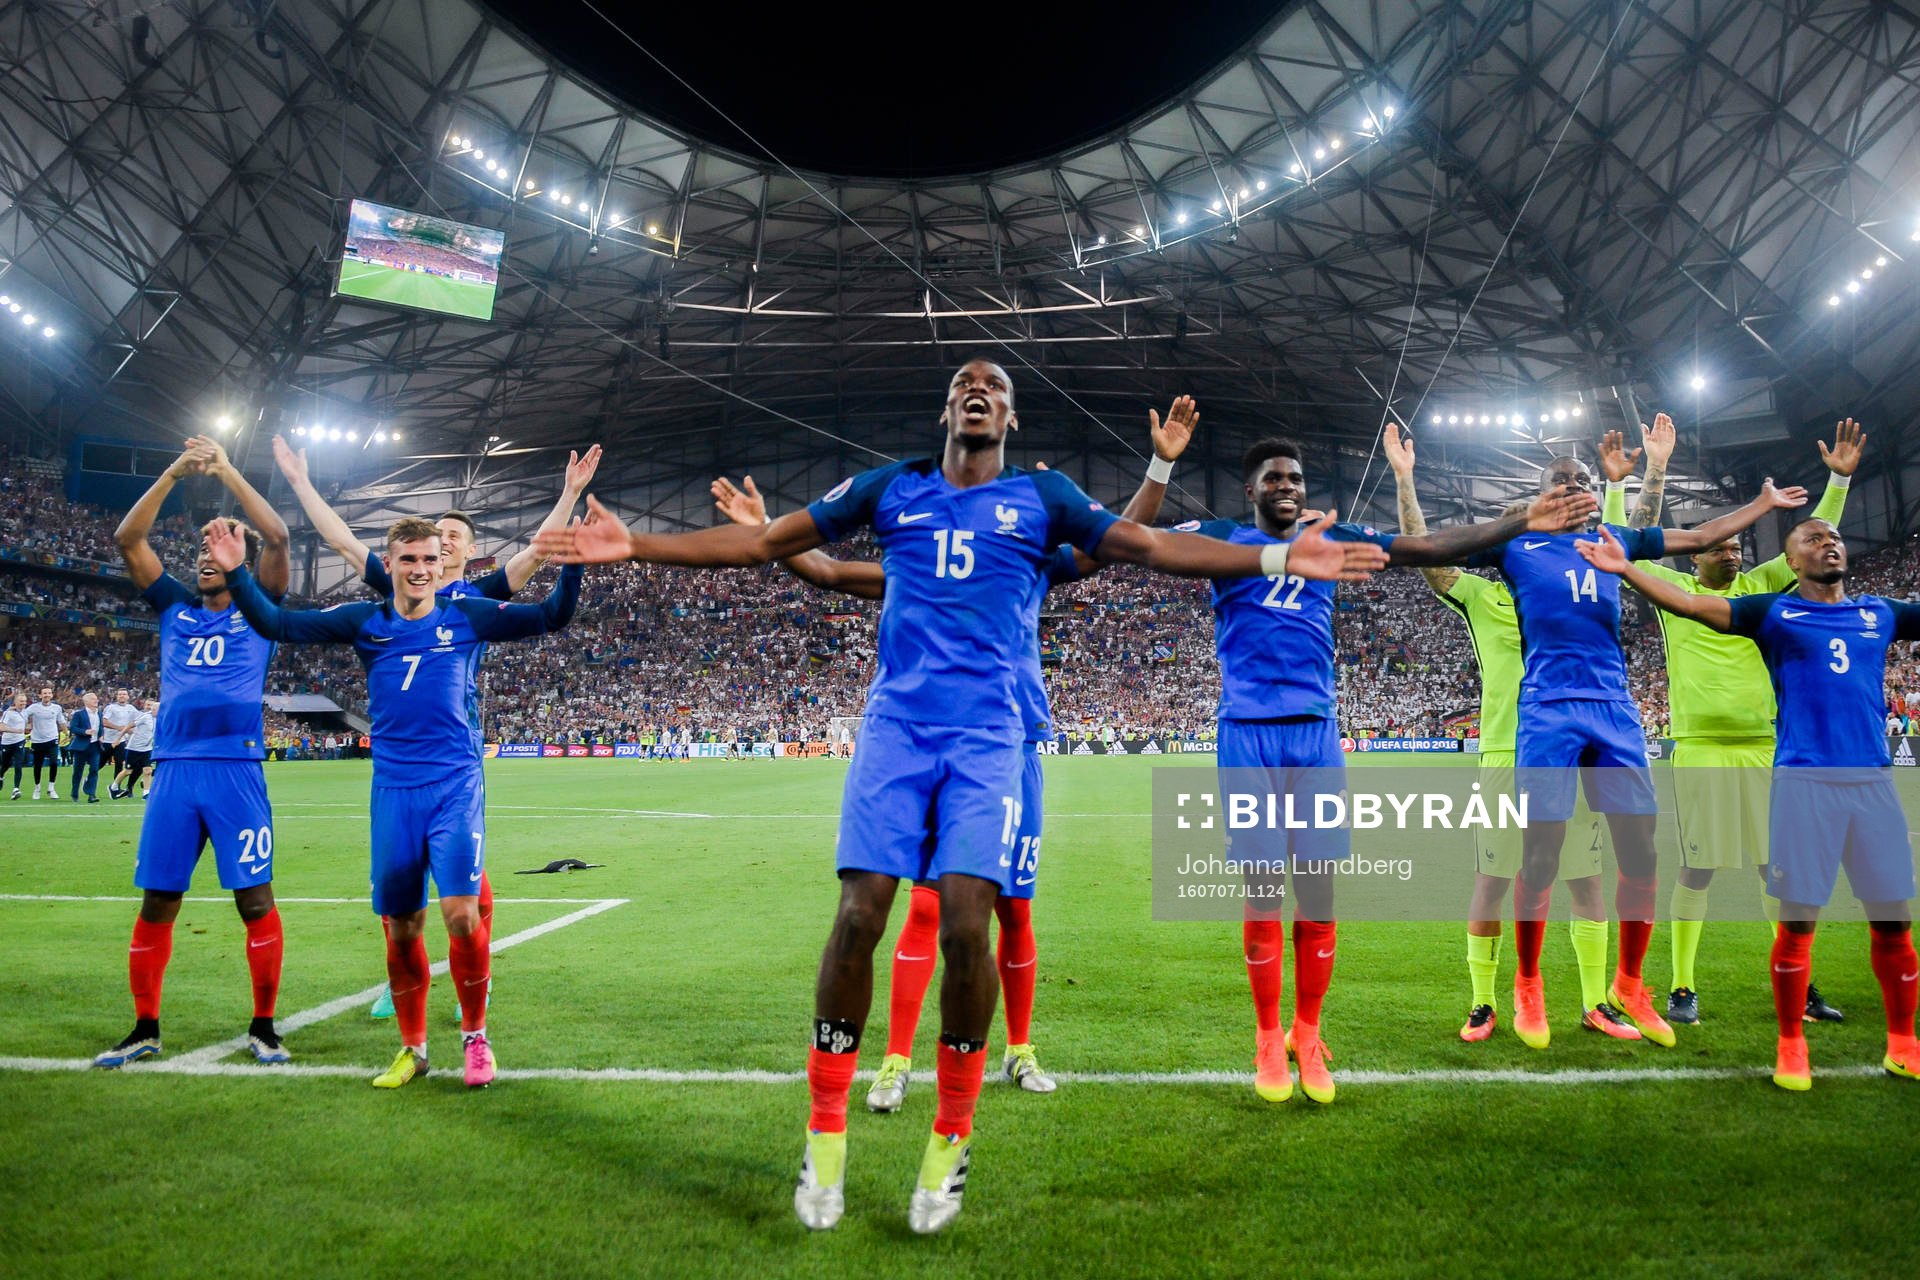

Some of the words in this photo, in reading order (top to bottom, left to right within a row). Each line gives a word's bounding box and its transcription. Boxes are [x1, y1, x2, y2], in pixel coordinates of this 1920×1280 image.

[934, 529, 975, 579] 15
[1262, 574, 1306, 610] 22
[1565, 568, 1599, 603] 14
[186, 635, 225, 666] 20
[1829, 638, 1850, 674] 3
[401, 655, 422, 691] 7
[616, 746, 637, 755] FDJ
[1373, 741, 1401, 750] UEFA
[1402, 741, 1430, 750] EURO
[1431, 740, 1458, 750] 2016
[238, 826, 272, 863] 20
[472, 832, 482, 867] 7
[1589, 821, 1602, 851] 2
[1017, 836, 1040, 872] 13
